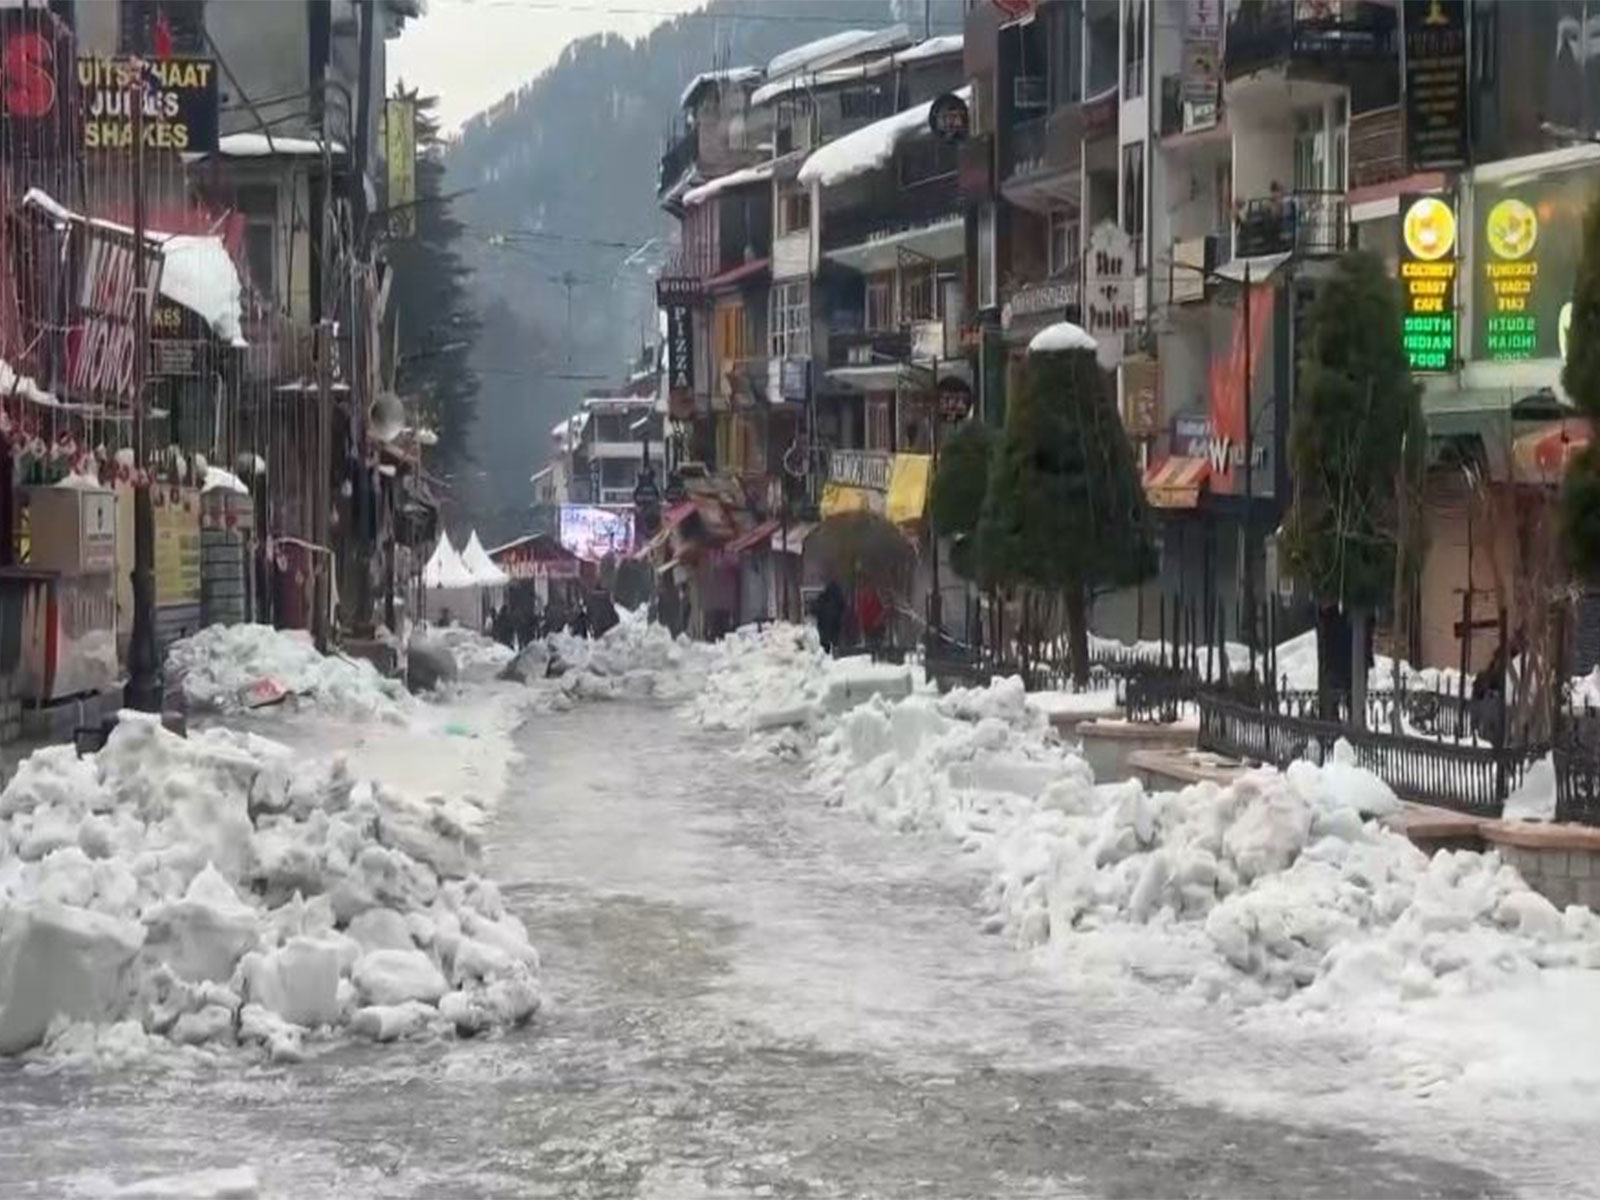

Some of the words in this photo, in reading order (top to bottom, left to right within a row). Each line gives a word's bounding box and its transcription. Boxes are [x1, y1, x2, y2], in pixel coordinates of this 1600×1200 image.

[1404, 317, 1452, 332] SOUTH
[674, 306, 688, 387] PIZZA
[1404, 336, 1452, 350] INDIAN
[1410, 354, 1446, 368] FOOD
